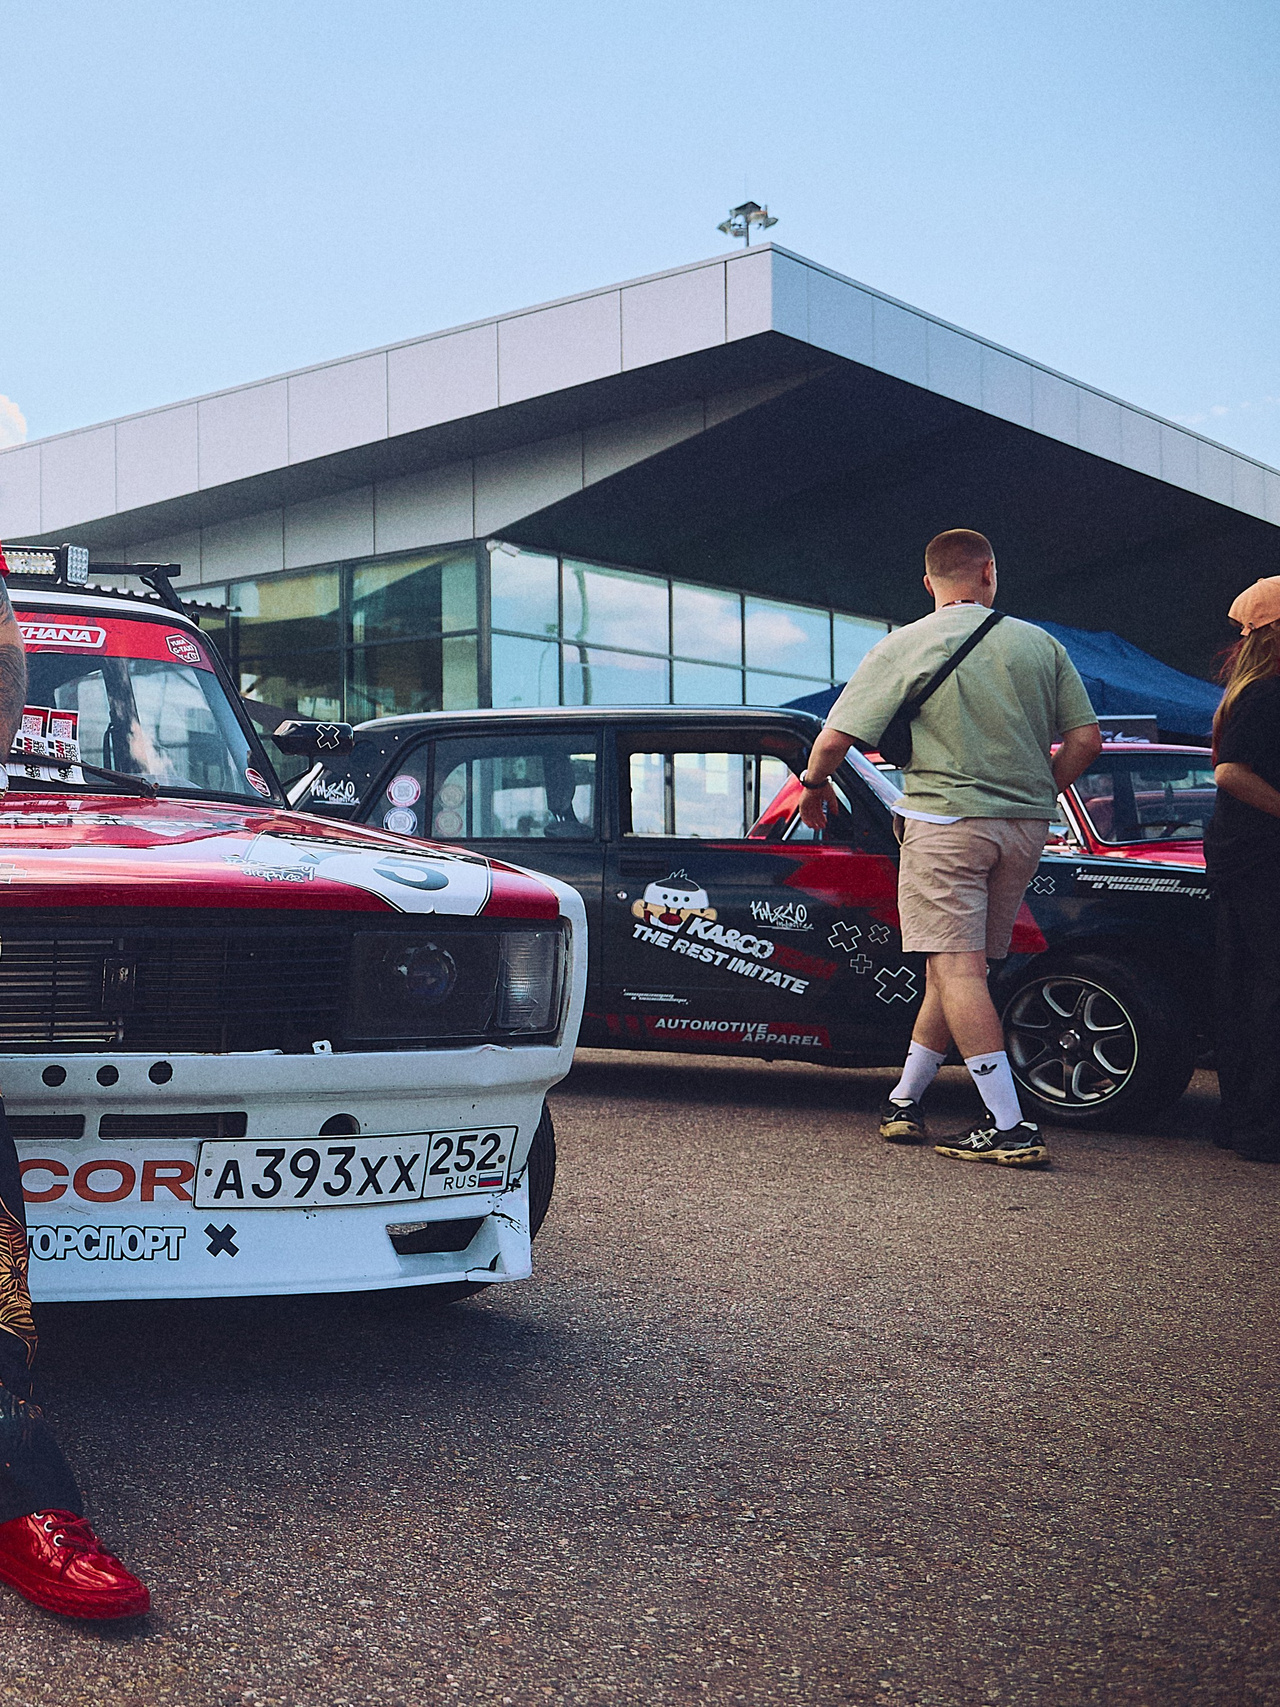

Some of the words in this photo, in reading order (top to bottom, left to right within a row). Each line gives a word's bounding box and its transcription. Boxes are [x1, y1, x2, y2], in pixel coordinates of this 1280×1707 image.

[686, 917, 775, 959] KA&CO
[632, 923, 674, 949] THE
[671, 938, 729, 967] REST
[726, 956, 810, 995] IMITATE
[654, 1017, 769, 1034] AUTOMOTIVE
[741, 1031, 823, 1046] APPAREL
[443, 1174, 477, 1190] RUS
